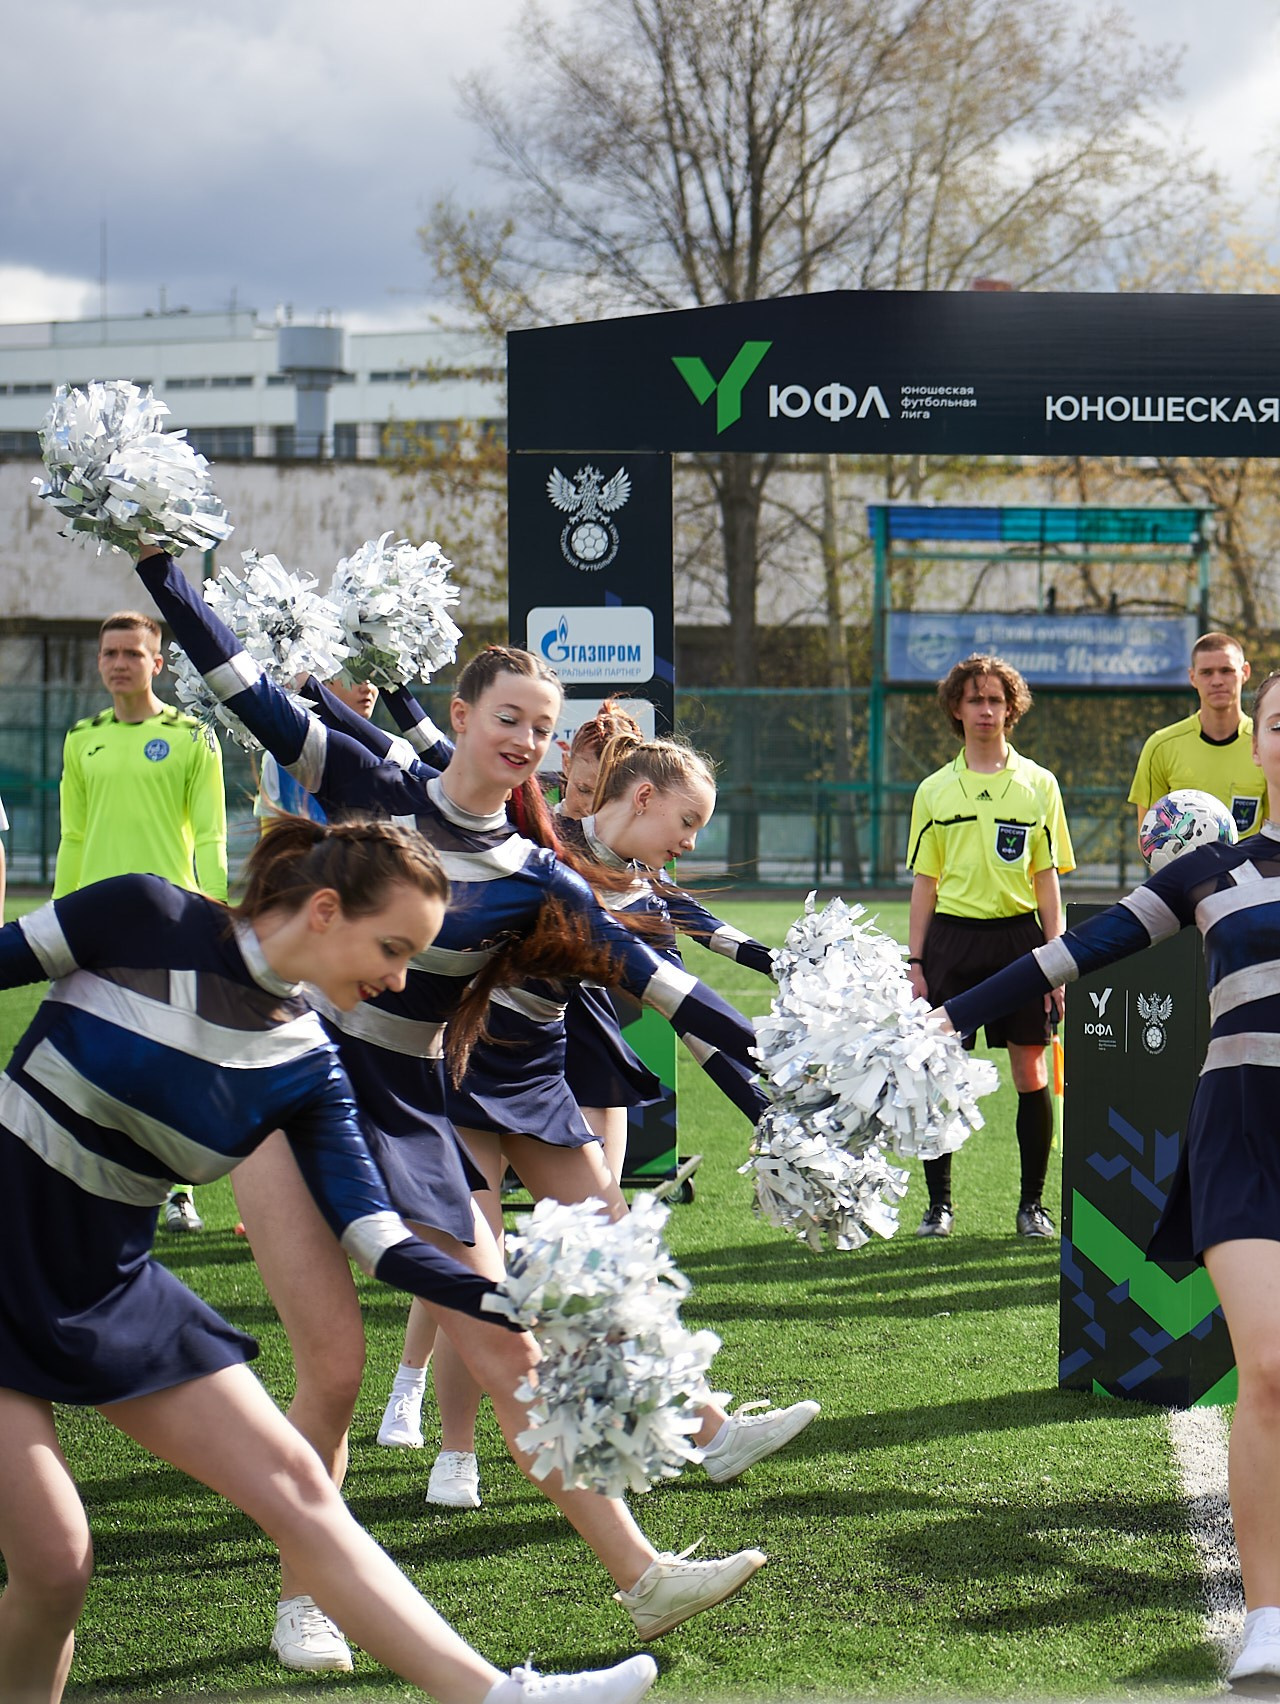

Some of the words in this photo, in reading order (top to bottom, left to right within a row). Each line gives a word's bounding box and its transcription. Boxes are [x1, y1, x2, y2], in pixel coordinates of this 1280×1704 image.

[900, 386, 975, 395] юношеская
[768, 382, 891, 422] ЮФЛ
[900, 396, 978, 409] футбольная
[1045, 395, 1280, 423] ЮНОШЕСКАЯ
[900, 410, 931, 419] лига
[571, 644, 642, 663] ГАЗПРОМ
[556, 667, 602, 677] ЕРАЛЬНЫЙ
[604, 667, 642, 677] ПАРТНЕР
[1084, 1022, 1114, 1037] ЮФЛ
